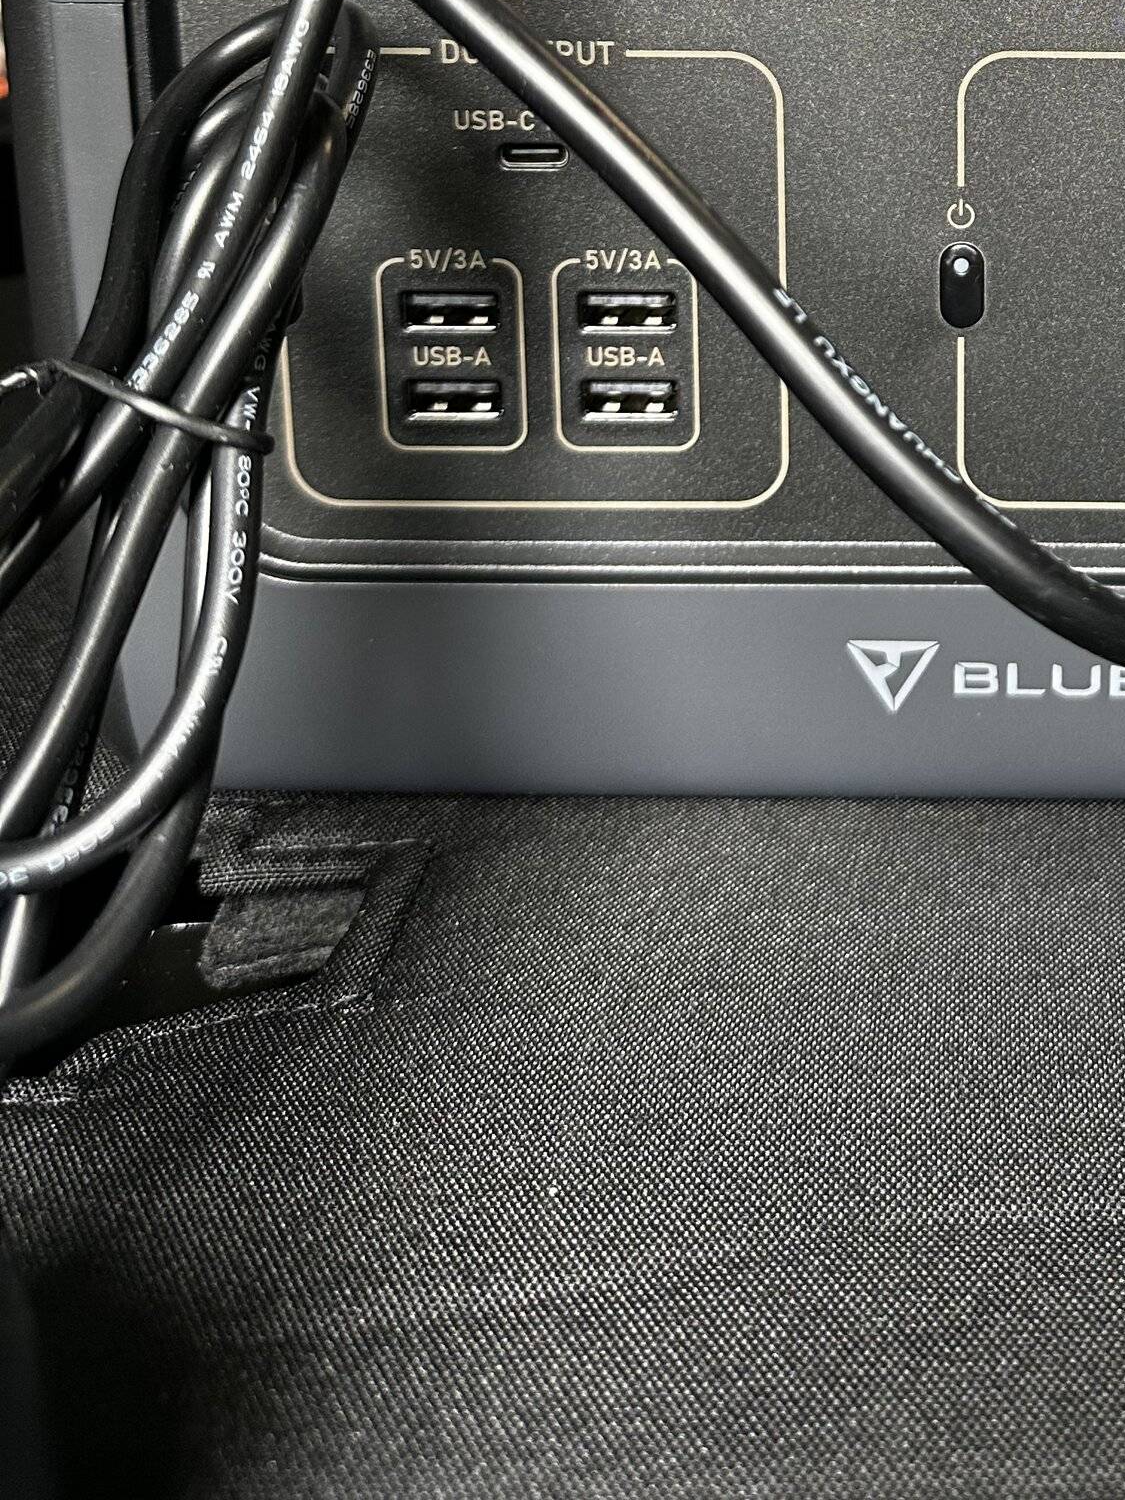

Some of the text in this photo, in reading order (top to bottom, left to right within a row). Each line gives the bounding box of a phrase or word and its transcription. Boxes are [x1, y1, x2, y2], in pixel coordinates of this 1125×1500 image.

[454, 109, 536, 131] USB-C
[409, 246, 487, 272] 5V/3A
[585, 247, 662, 273] 5V/3A
[127, 289, 200, 393] 336285
[413, 346, 493, 368] USB-A
[586, 346, 666, 368] USB-A
[241, 385, 261, 432] VW-
